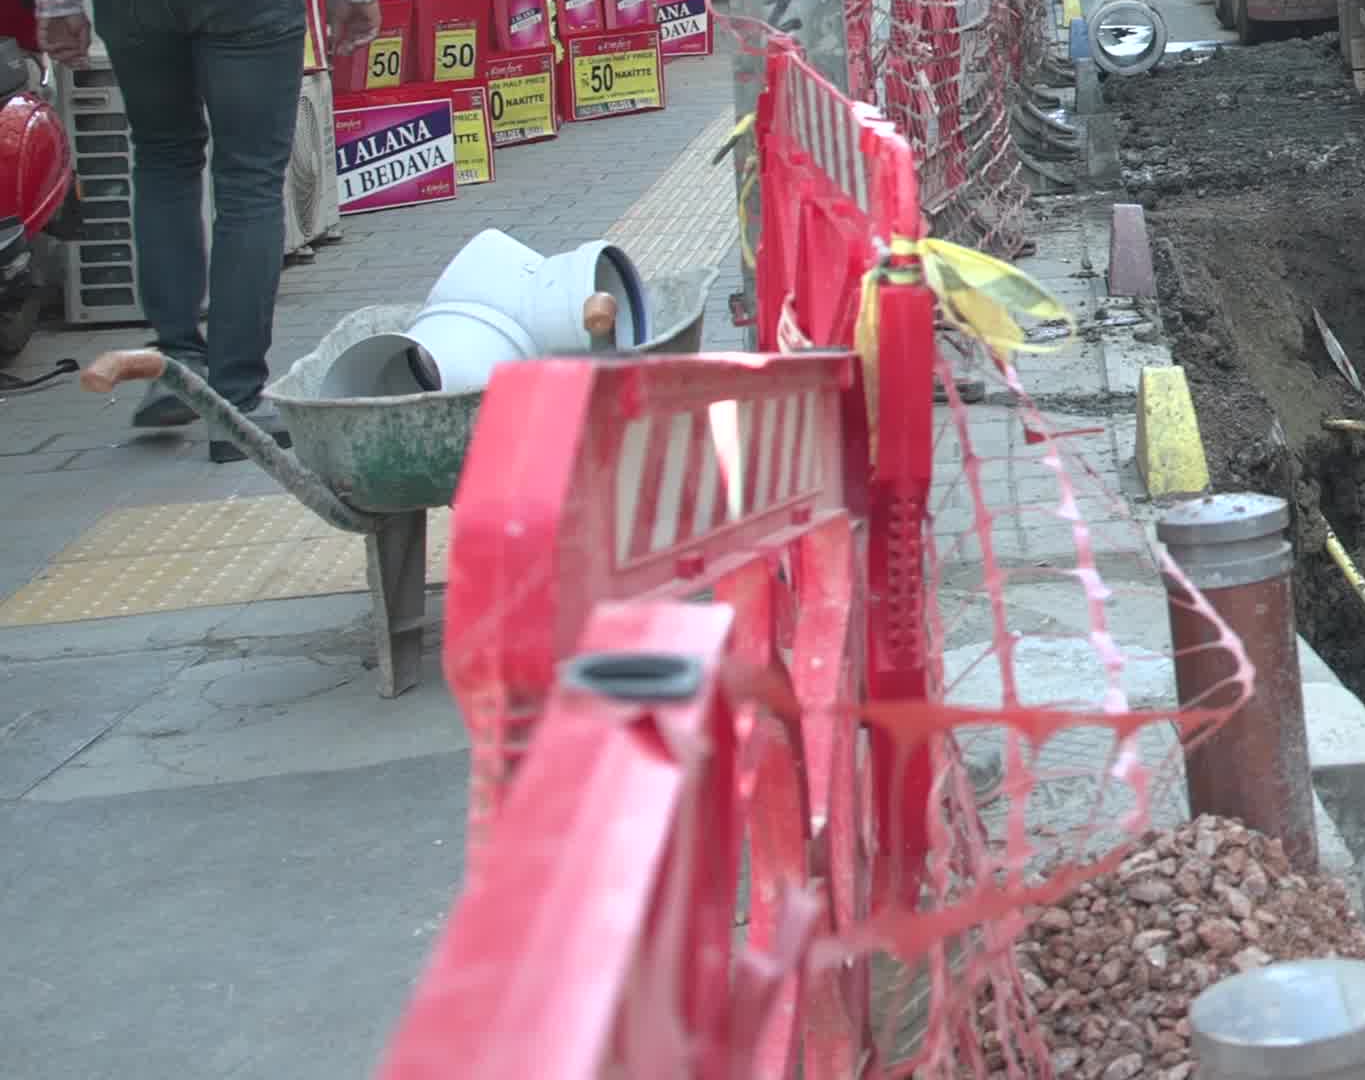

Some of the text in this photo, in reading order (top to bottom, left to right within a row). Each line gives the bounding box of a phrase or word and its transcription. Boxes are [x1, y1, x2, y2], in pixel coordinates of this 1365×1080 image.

[657, 2, 690, 23] ANA
[661, 19, 700, 39] DAVA
[490, 90, 504, 120] 0
[337, 119, 433, 169] 1 ALANA
[344, 143, 447, 198] 1 BEDAVA
